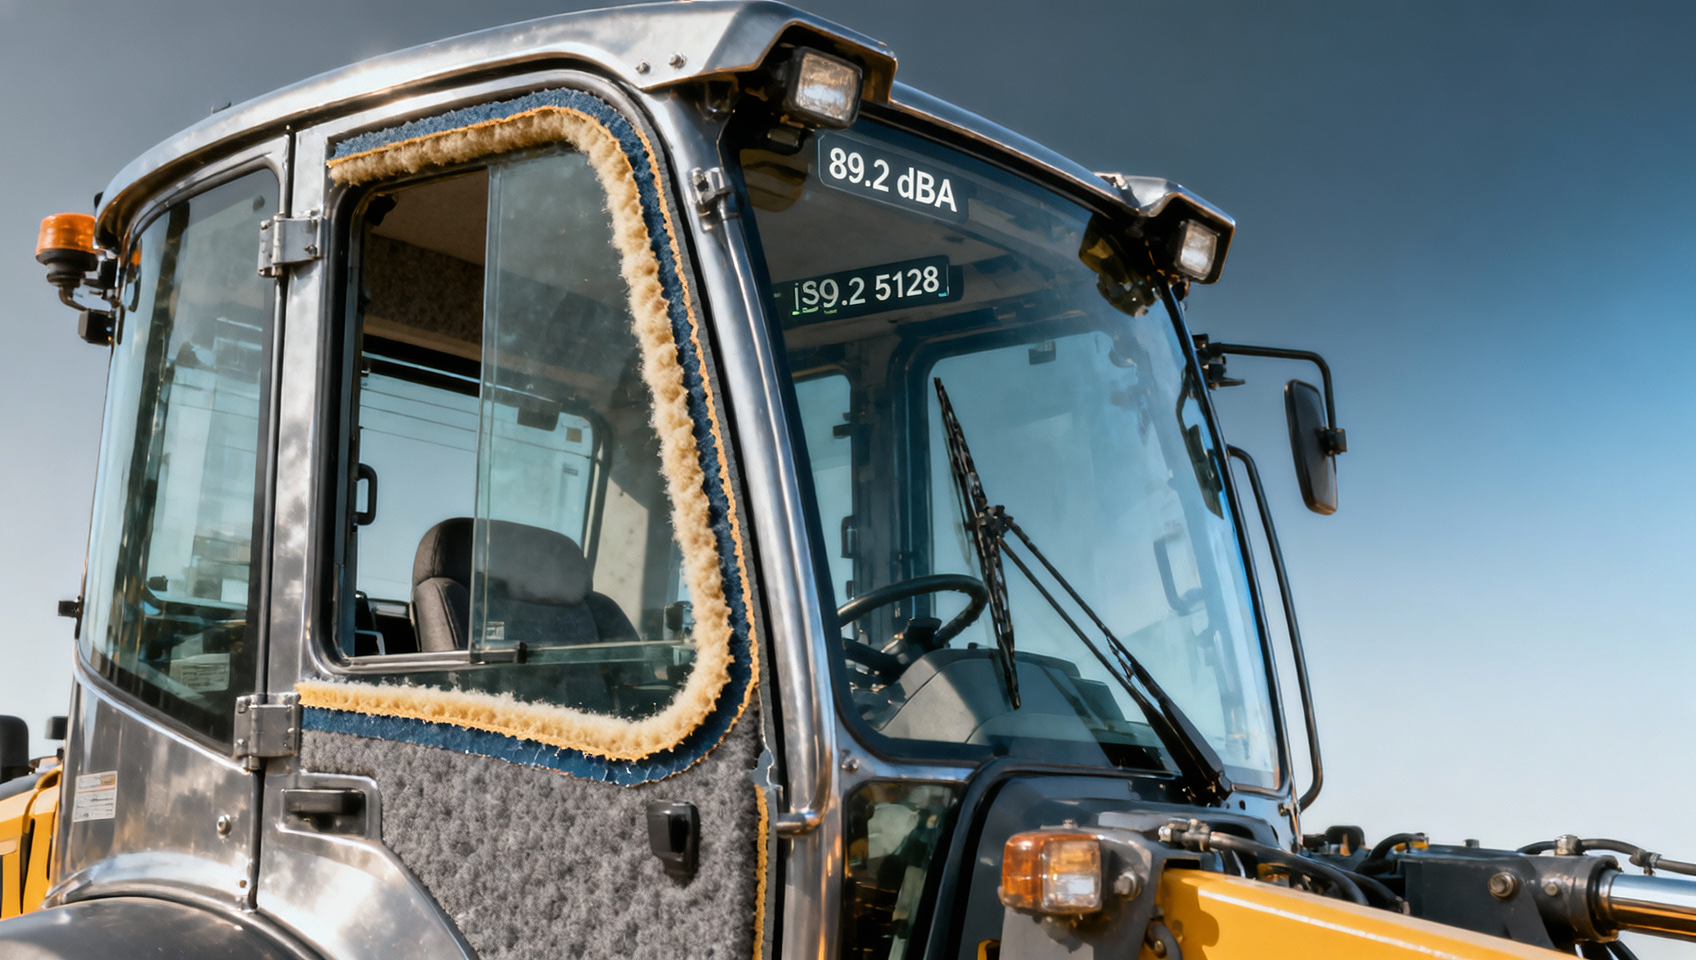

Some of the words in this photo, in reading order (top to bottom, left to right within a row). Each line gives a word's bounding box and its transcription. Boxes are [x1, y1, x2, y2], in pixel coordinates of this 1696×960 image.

[829, 148, 889, 192] 89.2
[897, 167, 957, 212] dBA
[875, 266, 939, 301] 5128
